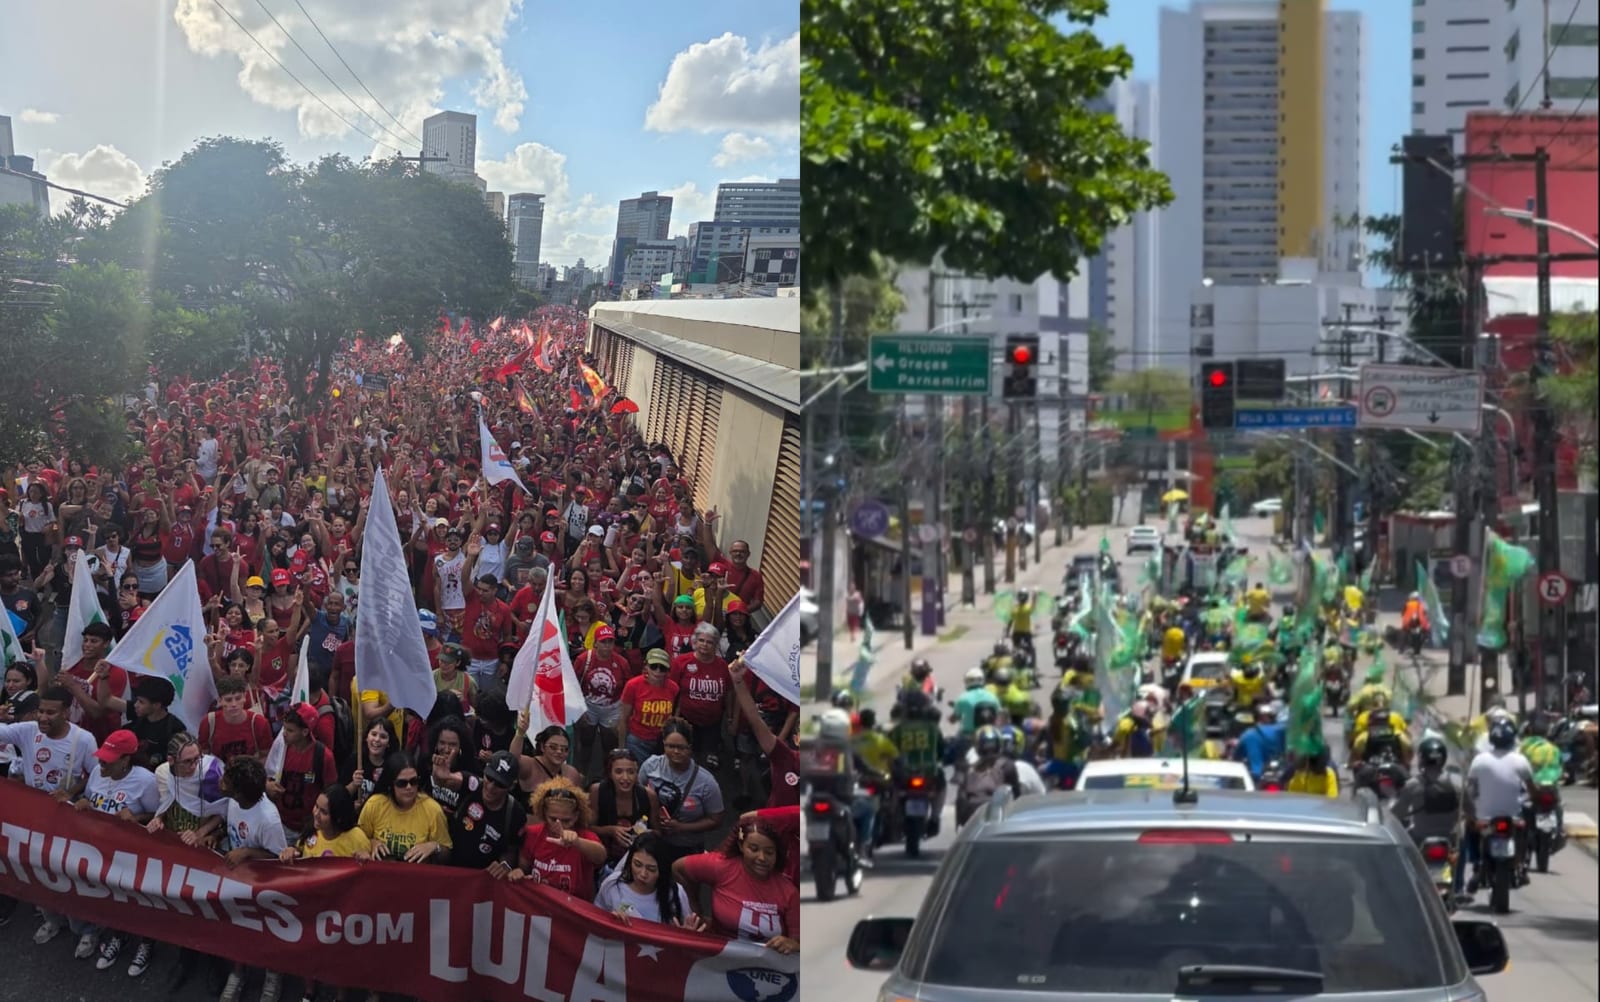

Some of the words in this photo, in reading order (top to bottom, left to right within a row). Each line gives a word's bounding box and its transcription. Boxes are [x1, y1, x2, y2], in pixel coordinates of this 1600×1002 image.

[898, 358, 948, 371] Graças
[898, 374, 986, 388] Parnamirim
[0, 822, 303, 943] TUDANTES
[315, 910, 414, 945] COM
[429, 898, 627, 1002] LULA
[749, 971, 782, 986] UNE
